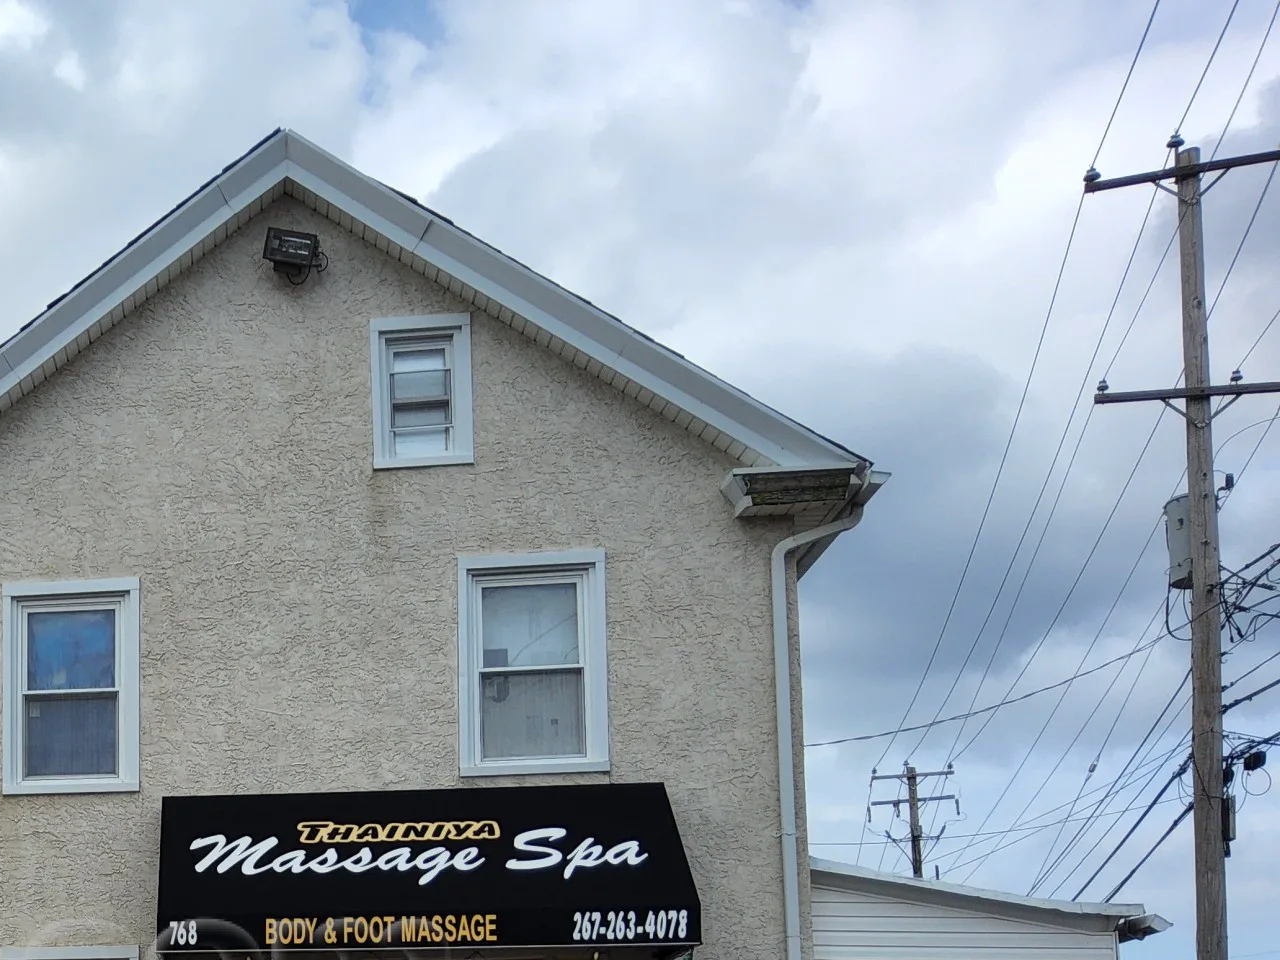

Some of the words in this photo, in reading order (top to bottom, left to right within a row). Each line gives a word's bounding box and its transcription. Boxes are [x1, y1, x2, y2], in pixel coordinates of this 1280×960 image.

[297, 820, 501, 843] THAINIYA
[190, 834, 485, 886] Massage
[505, 827, 648, 880] Spa
[170, 920, 197, 946] 768
[265, 917, 318, 945] BODY
[324, 917, 337, 944] &
[343, 916, 395, 944] FOOT
[401, 914, 497, 943] MASSAGE
[572, 909, 688, 941] 267-263-4078
